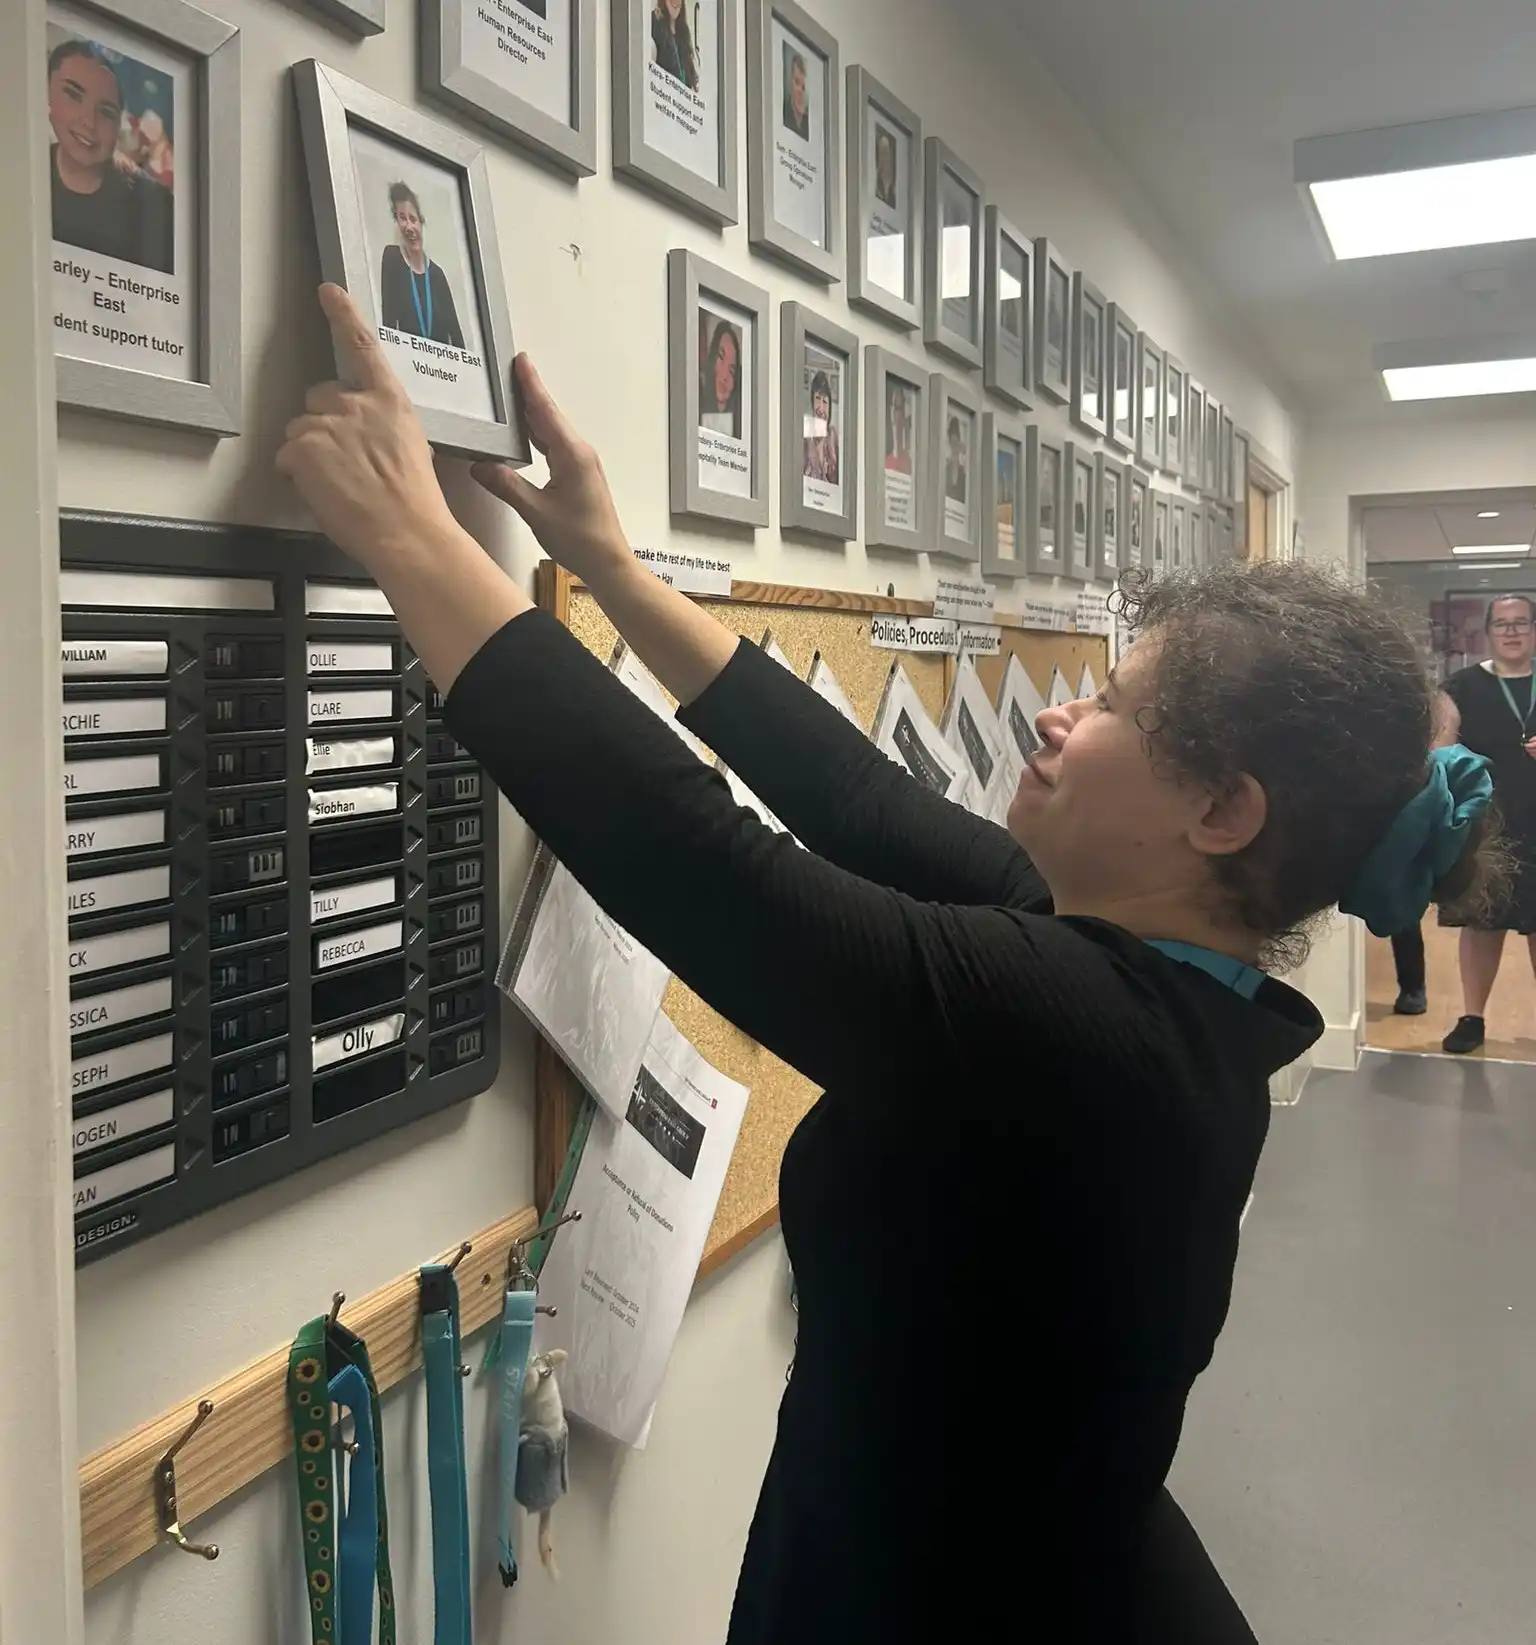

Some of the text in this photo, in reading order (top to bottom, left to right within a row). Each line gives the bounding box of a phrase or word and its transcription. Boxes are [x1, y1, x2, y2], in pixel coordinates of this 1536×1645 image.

[477, 6, 546, 60] Human Resources
[497, 0, 553, 46] Enterprise East
[497, 36, 528, 65] Director
[53, 259, 91, 284] arley
[108, 271, 181, 305] Enterprise
[93, 291, 126, 314] East
[53, 312, 185, 356] dent support tutor
[378, 327, 401, 345] Ellie
[411, 336, 459, 361] Enterprise
[461, 350, 482, 367] East
[412, 359, 458, 383] Volunteer
[633, 548, 731, 573] make the rest of my life the best
[872, 620, 909, 646] Policies,
[309, 653, 337, 667] OLLIE
[310, 702, 342, 716] CLARE
[62, 713, 101, 730] RCHIE
[312, 743, 331, 756] Ellie
[63, 774, 78, 790] RL
[457, 778, 475, 795] OUT
[315, 800, 356, 816] Siobhan
[67, 831, 96, 849] RRY
[458, 820, 476, 838] OUT
[253, 852, 277, 874] OUT
[458, 862, 478, 880] OUT
[68, 891, 97, 911] ILES
[313, 896, 340, 914] TILLY
[459, 905, 476, 924] OUT
[68, 950, 88, 968] CK
[322, 939, 366, 962] REBECCA
[459, 948, 476, 968] OUT
[69, 1006, 109, 1029] SSICA
[342, 1026, 375, 1054] Olly
[72, 1063, 109, 1089] SEPH
[72, 1119, 118, 1149] OGEN
[74, 1185, 98, 1208] AN
[602, 1163, 627, 1192] Acceptance
[651, 1207, 674, 1234] Donations
[626, 1203, 641, 1224] Policy
